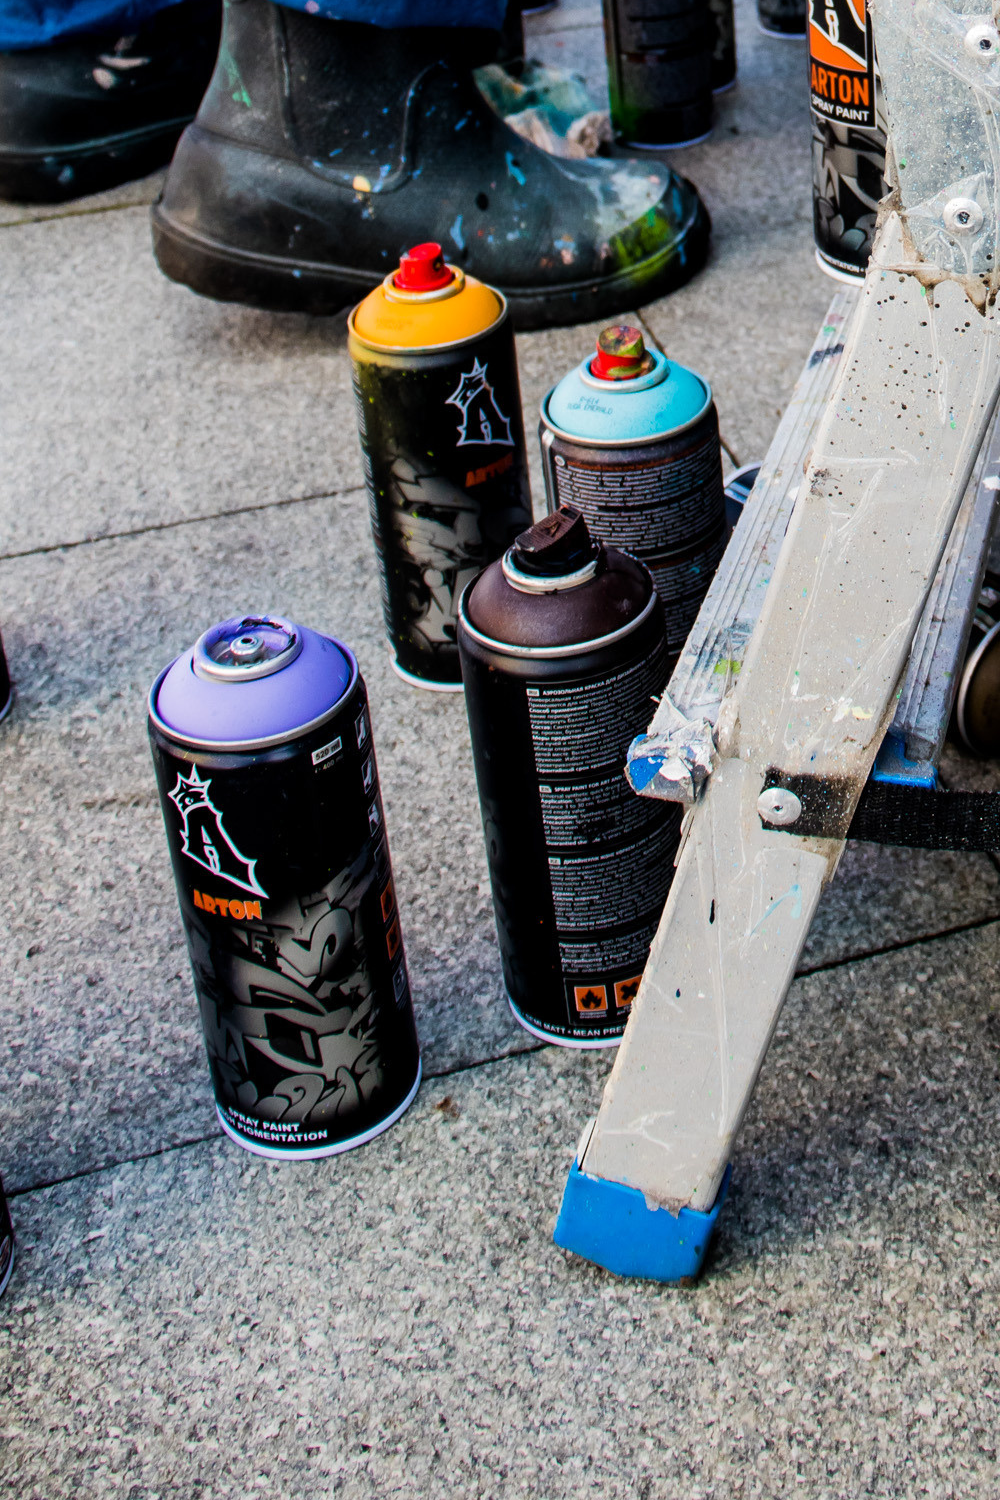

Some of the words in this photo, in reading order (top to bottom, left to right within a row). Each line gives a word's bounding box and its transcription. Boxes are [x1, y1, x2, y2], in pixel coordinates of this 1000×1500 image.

[811, 63, 869, 106] ARTON
[812, 94, 834, 114] SPRAY
[835, 105, 870, 122] PAINT
[315, 747, 330, 761] 520
[588, 781, 599, 789] FOR
[193, 888, 262, 920] ARTON
[543, 1023, 566, 1034] MATT
[228, 1107, 259, 1128] SPRAY
[262, 1121, 300, 1132] PAINT
[237, 1122, 328, 1142] PIGMENTATION
